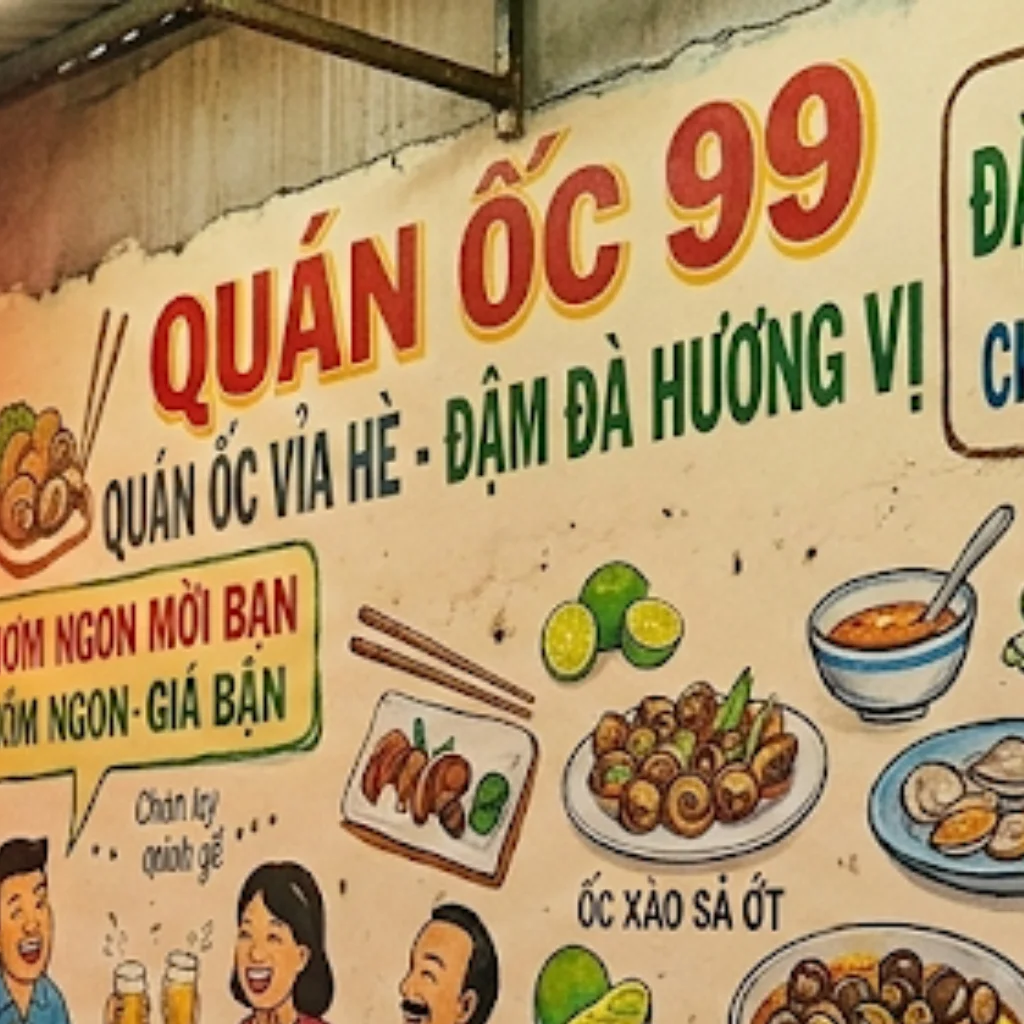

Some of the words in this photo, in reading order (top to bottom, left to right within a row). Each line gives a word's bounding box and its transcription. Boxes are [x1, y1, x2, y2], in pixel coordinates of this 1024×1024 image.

[148, 209, 425, 436] QUÁN
[457, 126, 630, 342] ỐC
[664, 58, 877, 286] 99
[102, 448, 195, 562] QUÁN
[209, 419, 257, 531] ỐC
[270, 402, 334, 518] VỈA
[347, 390, 400, 505] HÈ
[443, 365, 548, 496] ĐẬM
[564, 333, 633, 460] ĐÀ
[651, 302, 844, 441] HƯƠNG
[864, 281, 923, 414] VỊ
[55, 603, 136, 665] NGON
[149, 577, 210, 653] MỜI
[224, 575, 298, 650] BẠN
[48, 685, 129, 741] NGON
[146, 661, 201, 734] GIÁ
[577, 871, 615, 930] ỐC
[623, 875, 684, 931] XÀO
[742, 871, 785, 931] ỚT
